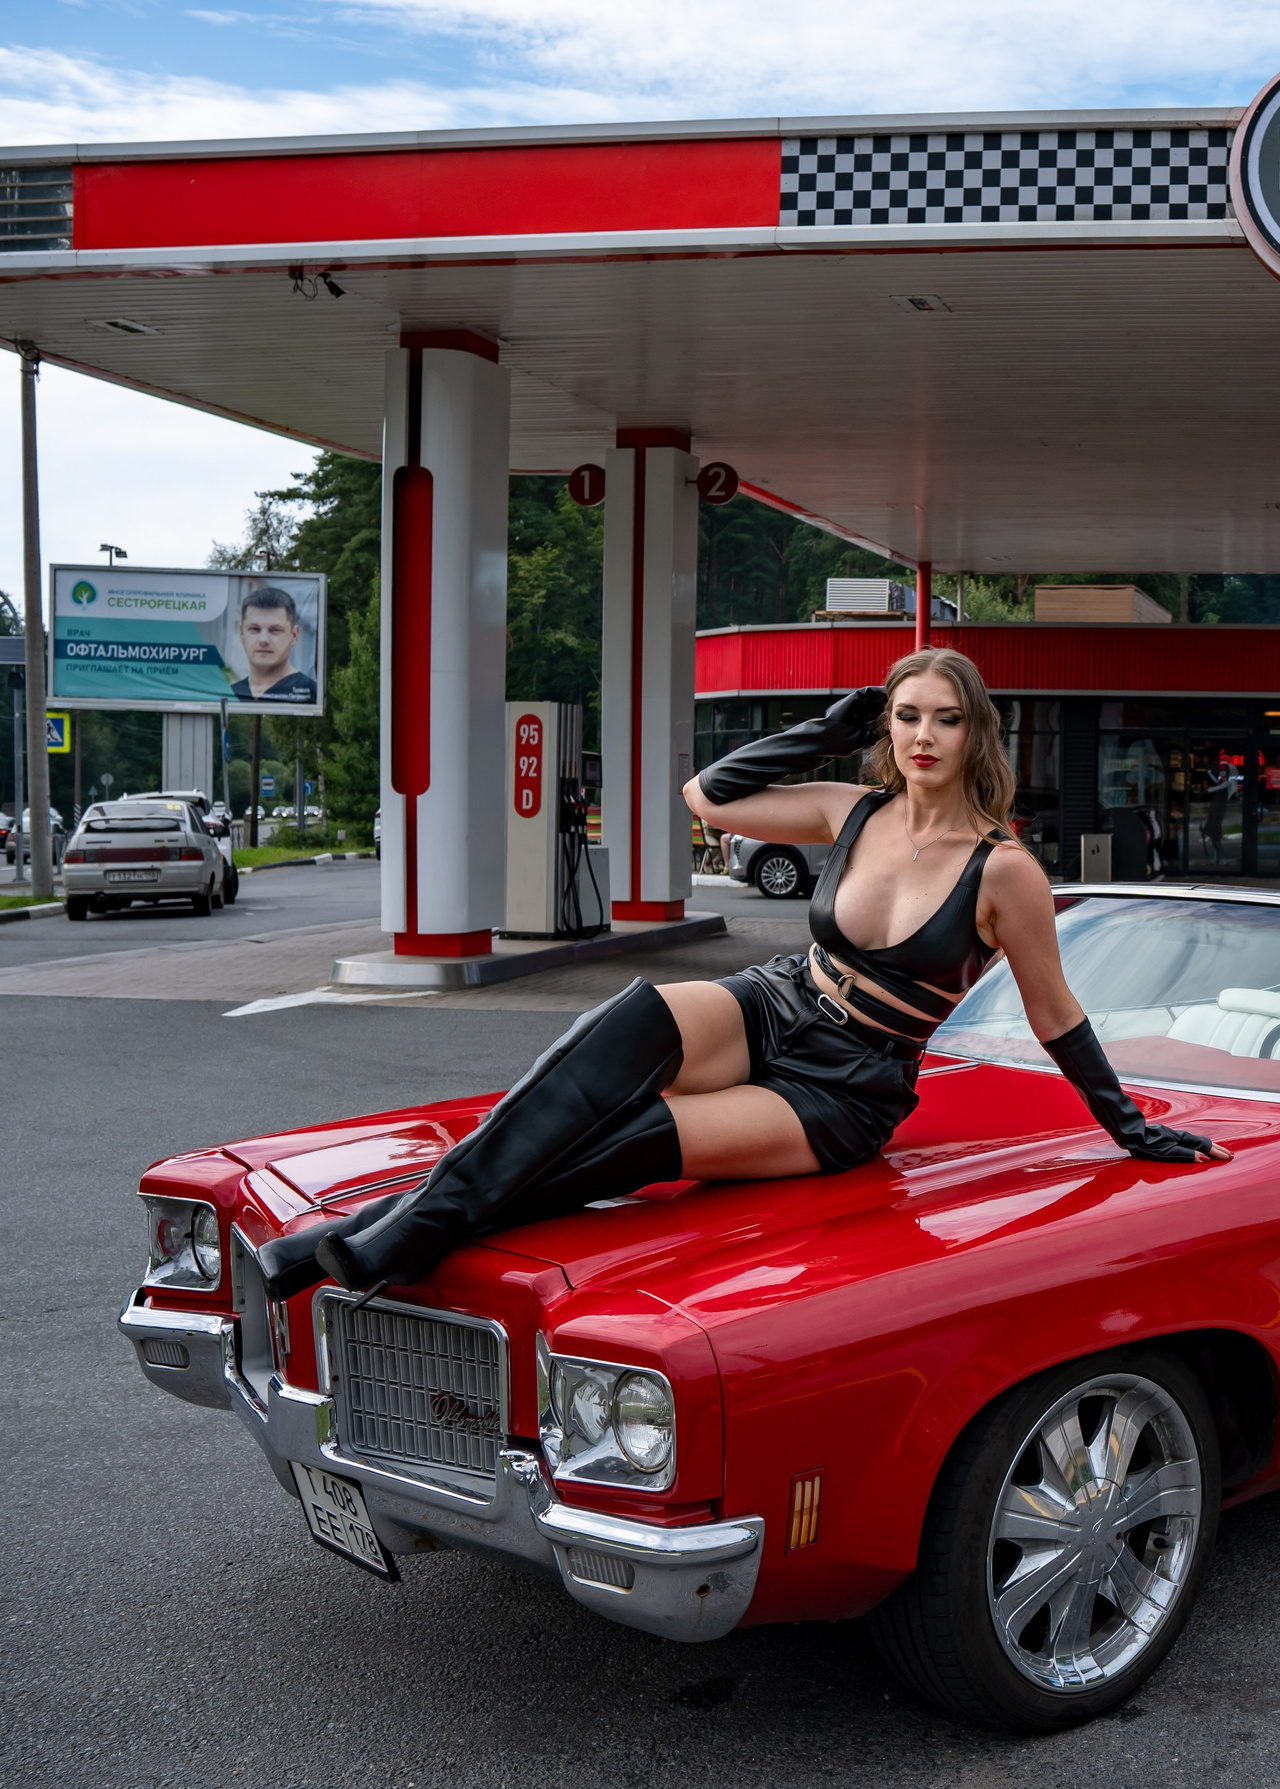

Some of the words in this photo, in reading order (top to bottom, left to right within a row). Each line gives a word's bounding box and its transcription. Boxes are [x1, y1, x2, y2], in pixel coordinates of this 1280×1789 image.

[580, 470, 590, 500] 1
[706, 467, 726, 496] 2
[107, 597, 207, 611] СЕСТРОРЕЦКАЯ
[66, 629, 91, 637] ВРАЧ
[66, 643, 208, 661] ОФТАЛЬМОХИРУРГ
[66, 663, 130, 674] ПРИГЛАШАЕТ
[131, 665, 144, 674] НА
[519, 724, 539, 745] 95
[519, 756, 538, 777] 92
[521, 788, 533, 810] D
[431, 1395, 501, 1431] Oldsmobile
[322, 1475, 358, 1517] 408
[348, 1522, 378, 1556] 178
